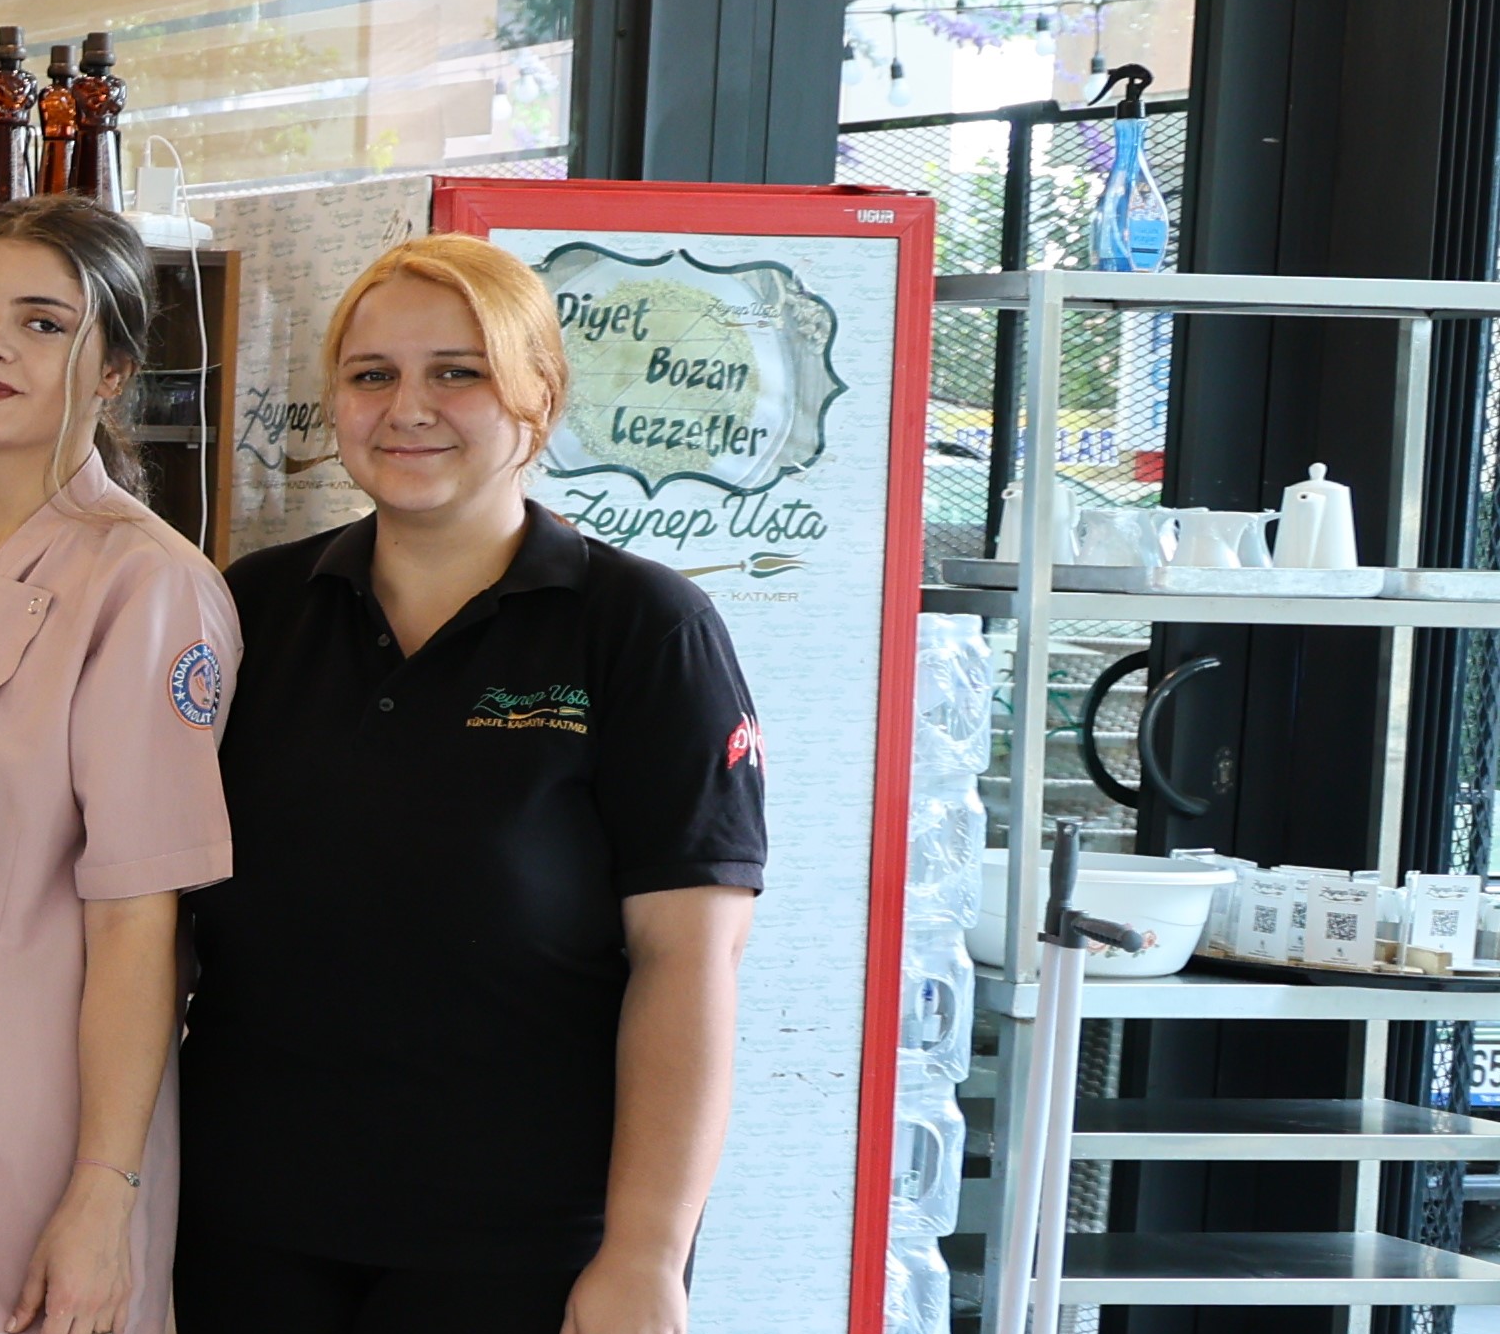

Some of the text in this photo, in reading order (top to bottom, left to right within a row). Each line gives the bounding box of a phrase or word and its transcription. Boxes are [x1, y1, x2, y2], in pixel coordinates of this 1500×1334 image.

[557, 292, 651, 342] Diyet
[646, 346, 749, 393] Bozan
[237, 387, 323, 470] Zeynep
[611, 405, 768, 457] Lezzetler
[562, 489, 828, 551] Zeynep Usta
[731, 592, 799, 603] KATMER
[172, 648, 202, 688] ADANA
